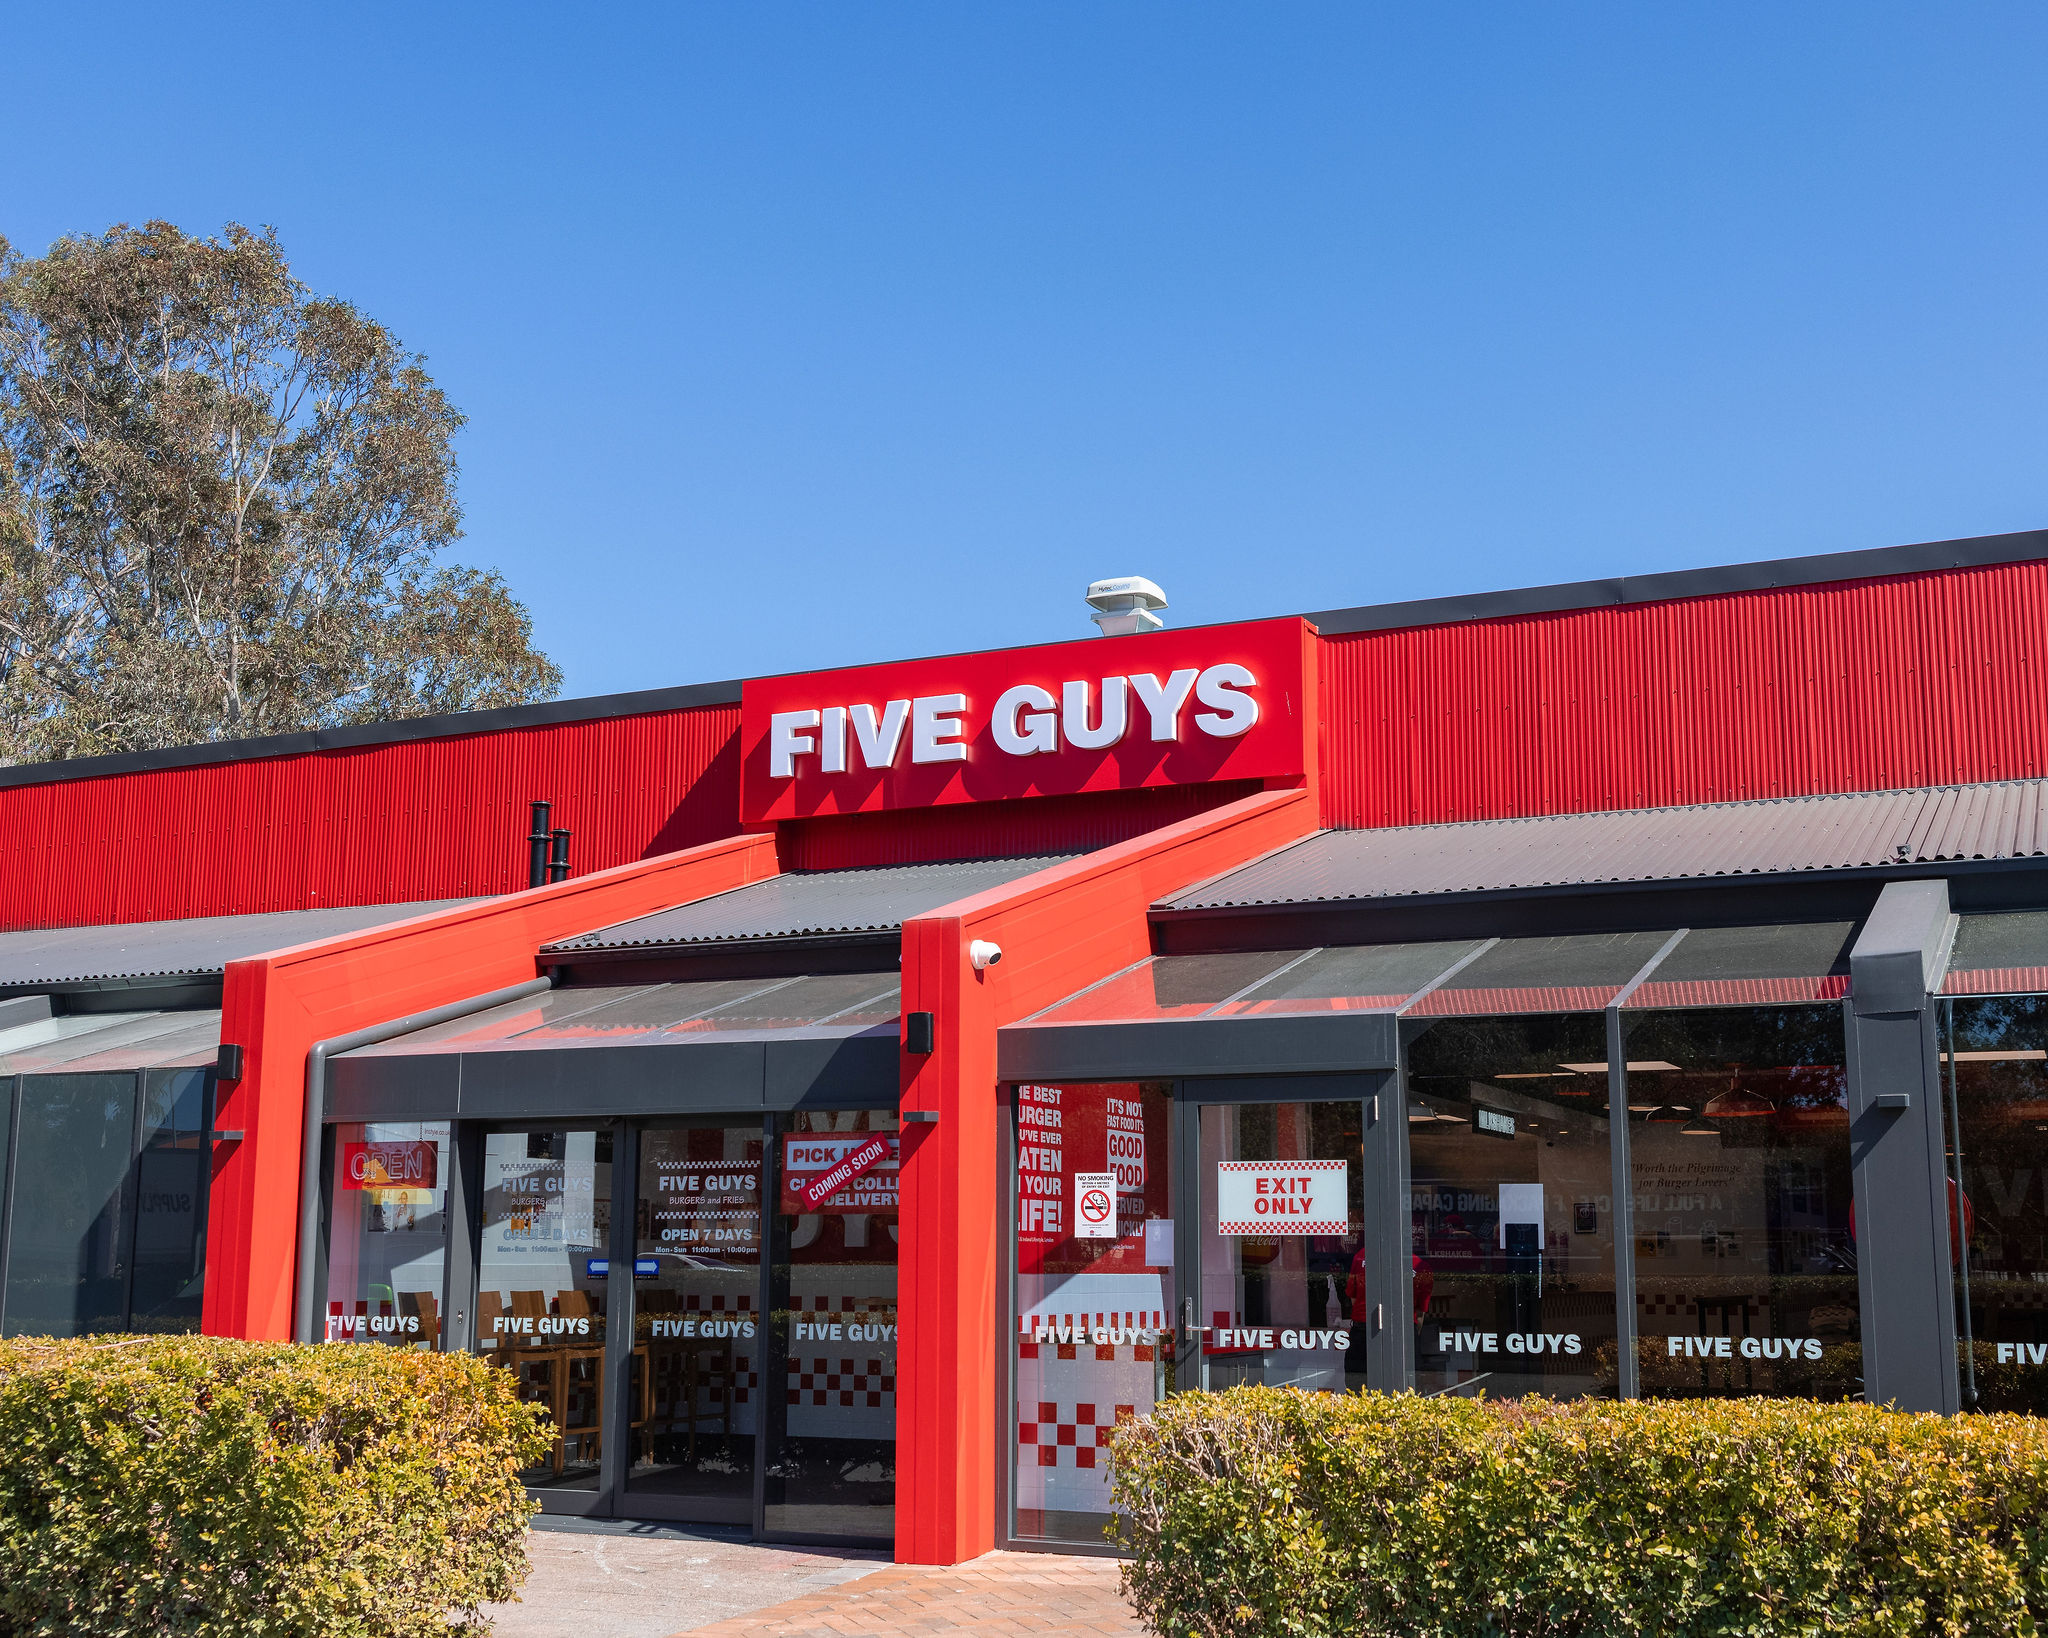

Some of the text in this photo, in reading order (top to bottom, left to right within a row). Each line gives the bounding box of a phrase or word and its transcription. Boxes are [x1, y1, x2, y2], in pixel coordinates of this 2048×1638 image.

[771, 663, 1260, 779] FIVE GUYS
[1034, 1086, 1062, 1105] BEST
[1106, 1097, 1143, 1118] IT'S NOT
[1106, 1114, 1119, 1128] FAST
[1120, 1116, 1134, 1130] FOOD
[1041, 1131, 1062, 1145] EVER
[1109, 1133, 1142, 1160] GOOD
[793, 1148, 836, 1163] PICK
[351, 1151, 423, 1181] OPEN
[809, 1164, 853, 1201] COMING
[851, 1141, 884, 1170] SOON
[501, 1177, 593, 1193] FIVE GUYS
[659, 1174, 757, 1191] FIVE GUYS
[853, 1176, 899, 1191] COLL
[1025, 1175, 1062, 1196] YOUR
[1255, 1177, 1312, 1195] EXIT
[511, 1197, 545, 1206] BURGERS
[670, 1195, 745, 1205] BURGERS and FRIES
[1254, 1197, 1314, 1215] ONLY
[1018, 1199, 1062, 1233] IFE!
[503, 1228, 538, 1241] OPEN
[553, 1228, 588, 1241] DAYS
[661, 1228, 752, 1241] OPEN 7 DAYS
[727, 1246, 757, 1254] 10:00pm
[328, 1315, 419, 1333] FIVE GUYS
[493, 1317, 589, 1335] FIVE GUYS
[652, 1320, 755, 1338] FIVE GUYS
[796, 1323, 842, 1341] FIVE
[1035, 1326, 1157, 1346] FIVE GUYS
[1220, 1329, 1350, 1350] FIVE GUYS
[1439, 1332, 1581, 1354] FIVE GUYS
[1668, 1336, 1822, 1360] FIVE GUYS
[1997, 1342, 2047, 1364] FIV
